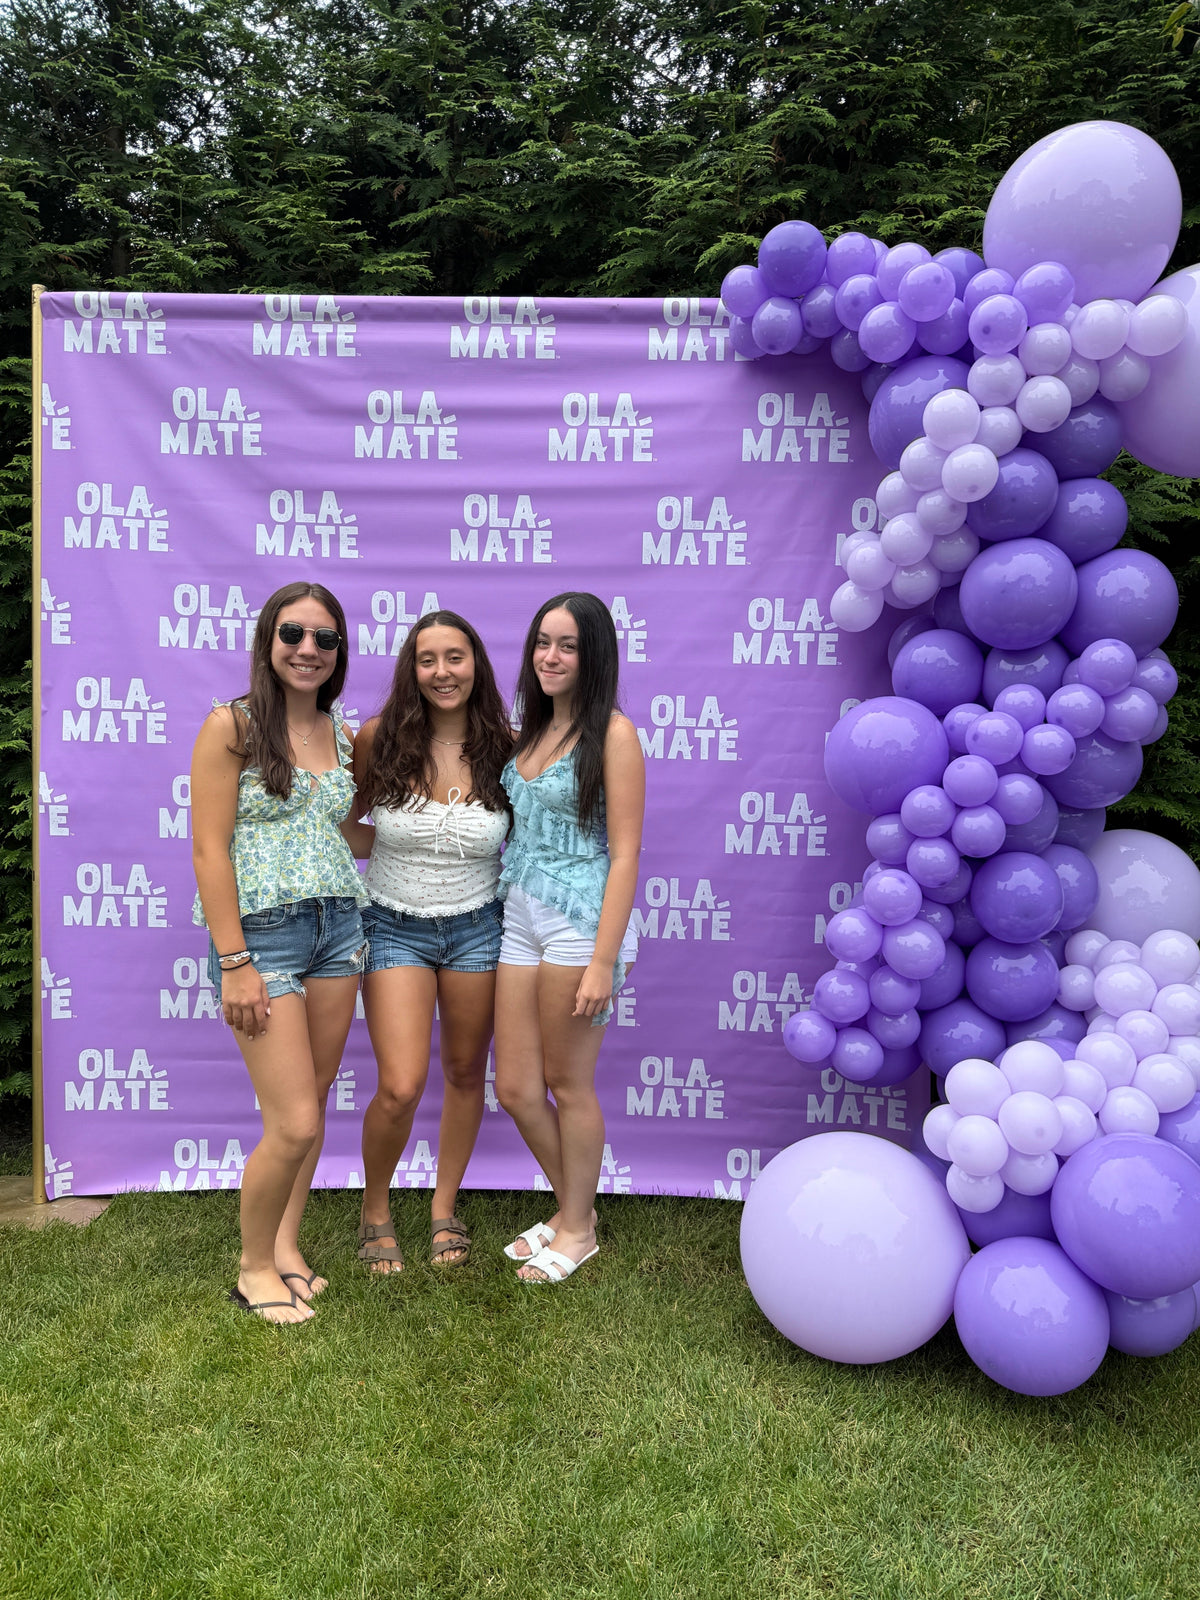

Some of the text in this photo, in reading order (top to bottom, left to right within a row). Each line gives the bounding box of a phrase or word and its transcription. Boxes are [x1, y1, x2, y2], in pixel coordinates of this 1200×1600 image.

[74, 291, 150, 320] OLA
[264, 294, 341, 323] OLA
[463, 297, 541, 326] OLA
[648, 327, 757, 362] MAT
[172, 386, 248, 422] OLA
[366, 390, 443, 425] OLA
[561, 392, 639, 427] OLA
[757, 393, 836, 427] OLA
[76, 481, 154, 519] OLA
[269, 489, 344, 525] OLA
[463, 493, 538, 529] OLA
[656, 496, 733, 531] OLA
[173, 583, 249, 619] OLA
[748, 597, 824, 631] OLA
[75, 676, 152, 711] OLA
[650, 694, 724, 729] OLA
[739, 791, 814, 824] OLA
[76, 862, 153, 896] OLA
[645, 877, 718, 910] OLA
[172, 957, 216, 988] OL
[732, 970, 805, 1003] OLA
[160, 989, 220, 1020] MA
[718, 997, 812, 1033] MAT
[78, 1048, 154, 1080] OLA
[640, 1055, 711, 1088] OLA
[173, 1138, 248, 1171] OLA
